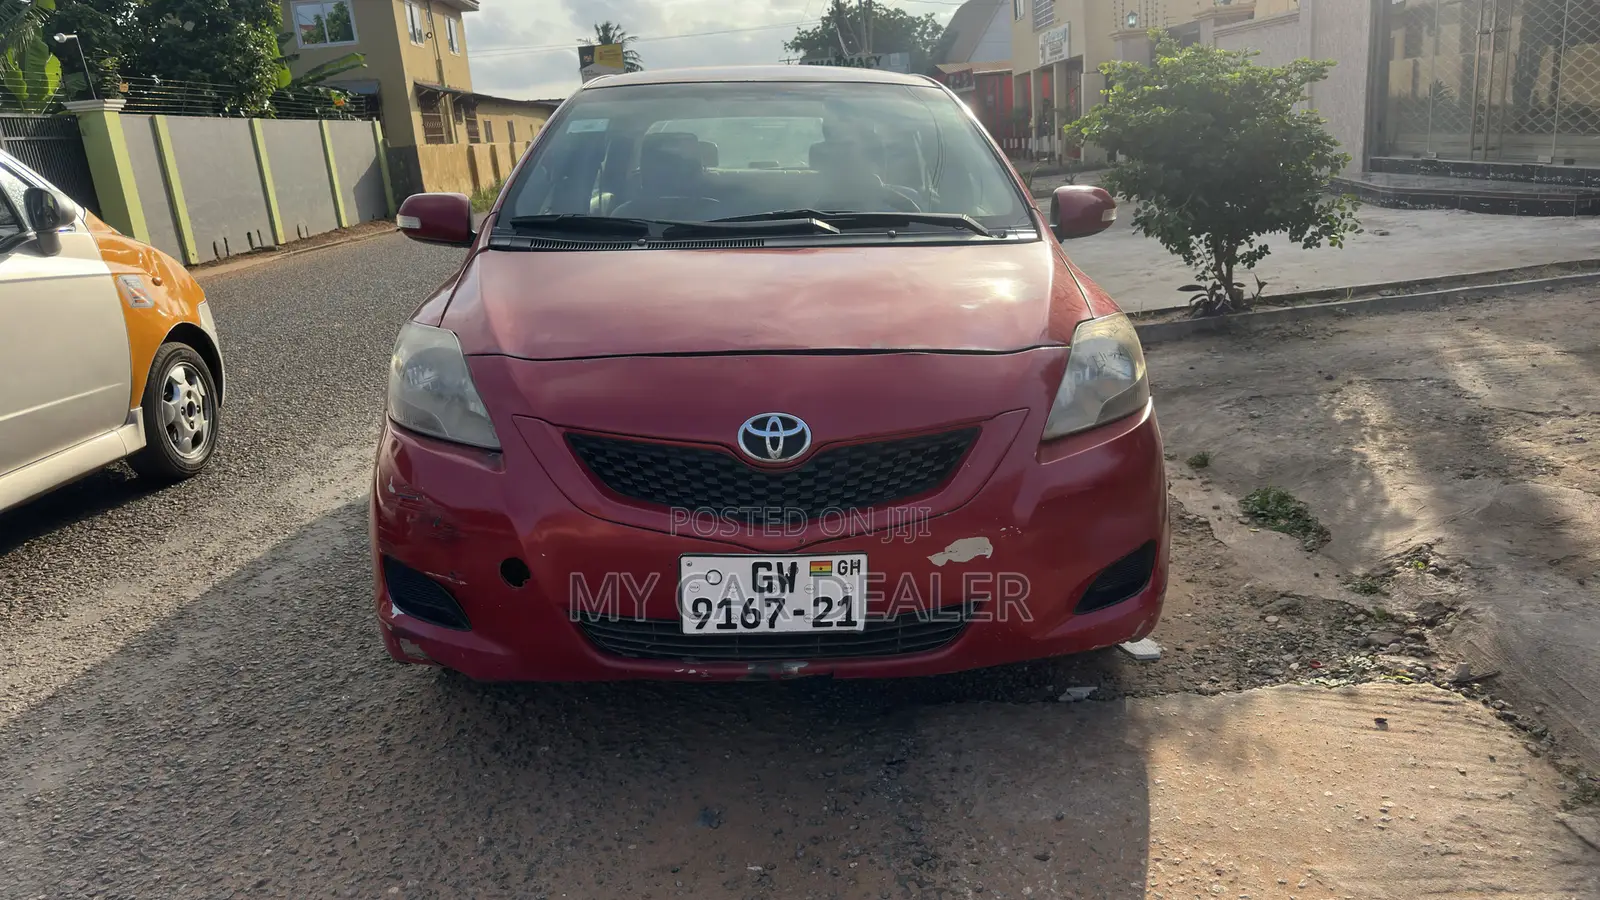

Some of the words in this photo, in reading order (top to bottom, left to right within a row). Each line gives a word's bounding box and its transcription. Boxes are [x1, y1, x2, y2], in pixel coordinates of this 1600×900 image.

[751, 561, 798, 593] GW
[837, 559, 861, 576] GH
[691, 595, 858, 630] 9167-21
